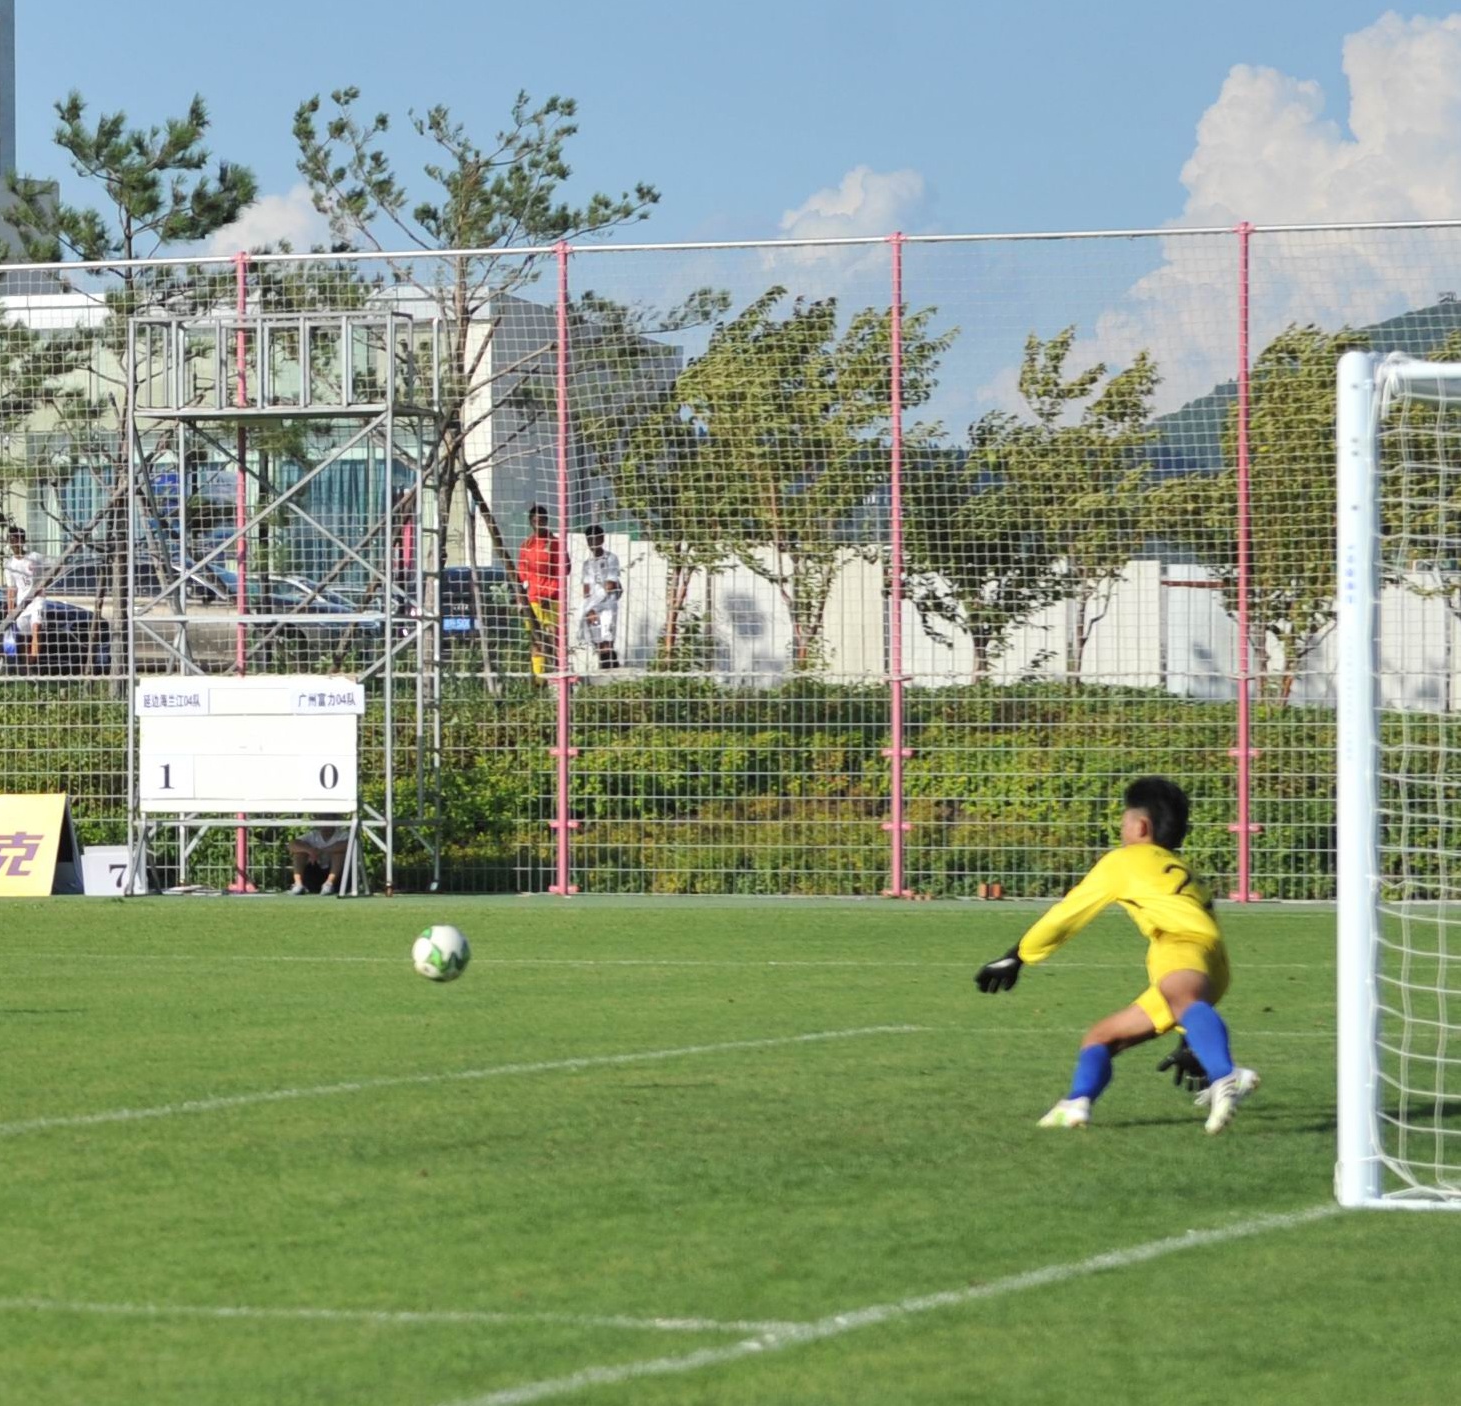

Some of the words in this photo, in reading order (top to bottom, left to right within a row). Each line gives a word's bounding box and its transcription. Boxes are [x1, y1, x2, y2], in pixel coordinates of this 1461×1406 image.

[159, 763, 175, 790] 1
[319, 763, 339, 790] 0
[109, 863, 128, 888] 7
